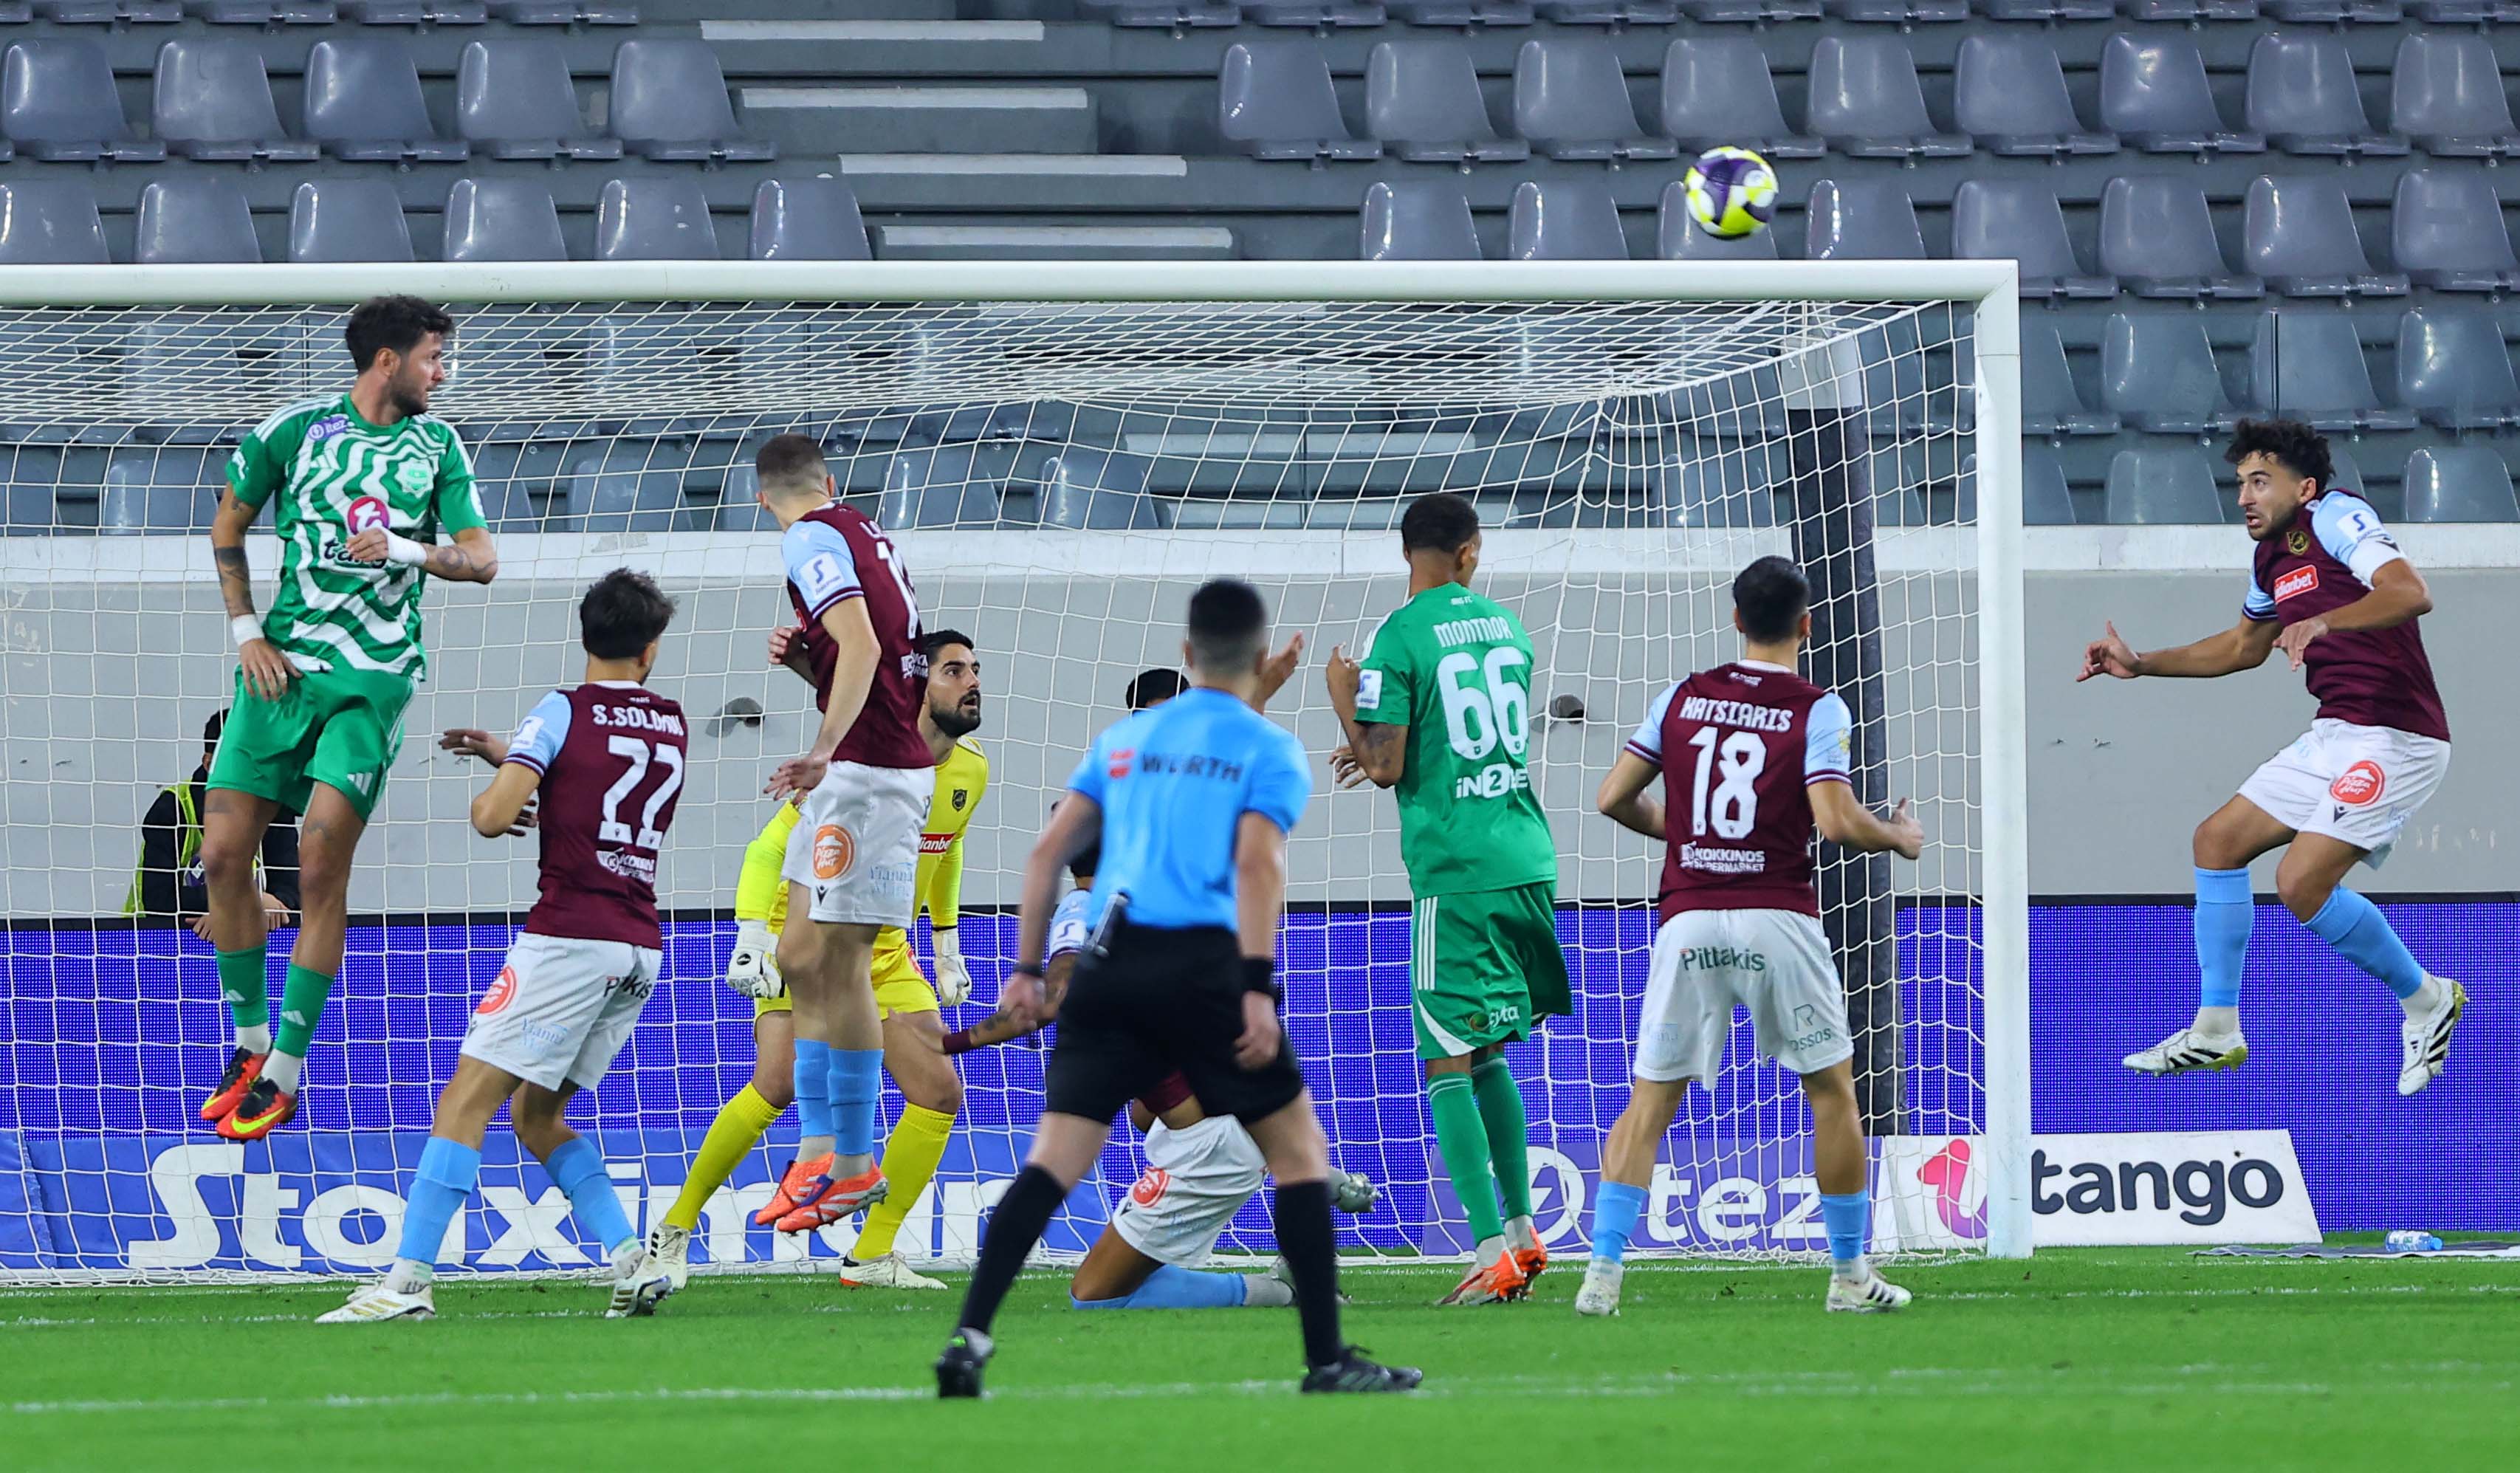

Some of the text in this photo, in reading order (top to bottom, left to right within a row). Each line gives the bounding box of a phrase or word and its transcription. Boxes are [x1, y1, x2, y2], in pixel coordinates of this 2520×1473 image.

[1437, 646, 1528, 760] 66
[598, 735, 684, 851] 22
[1688, 726, 1768, 840] 18
[2032, 1149, 2284, 1226] tango
